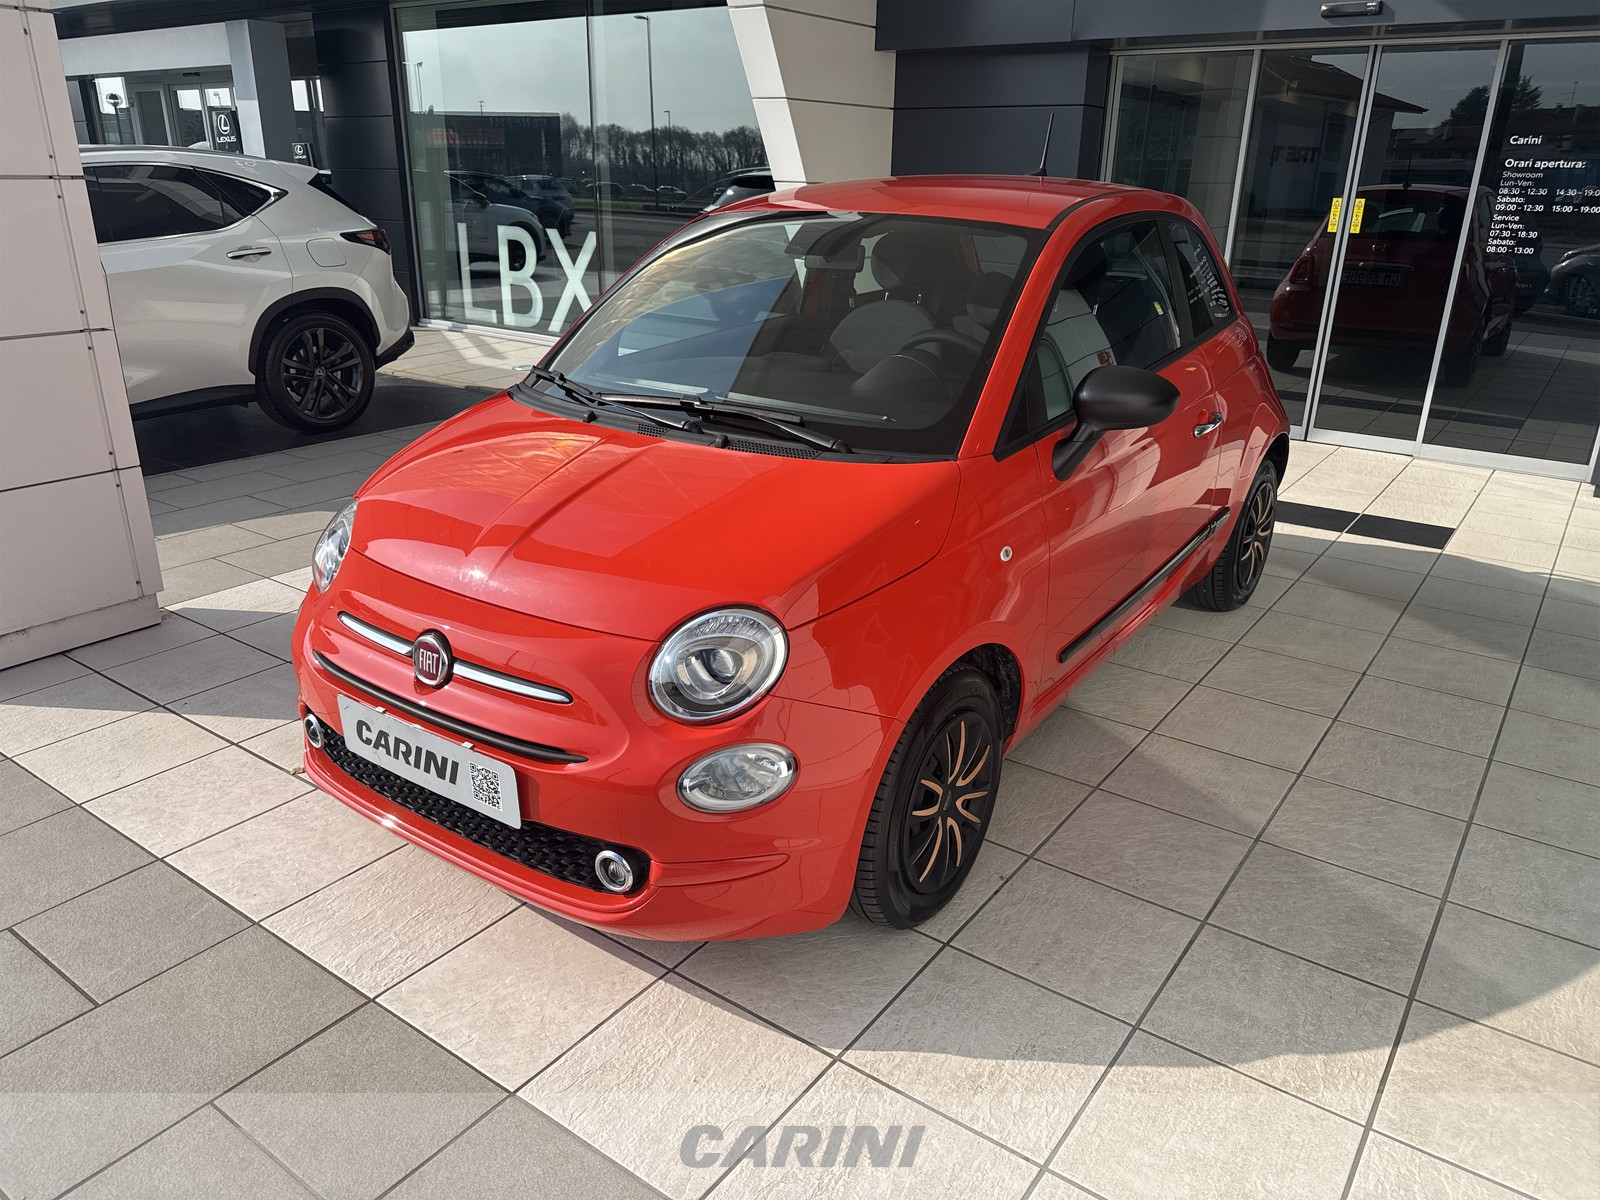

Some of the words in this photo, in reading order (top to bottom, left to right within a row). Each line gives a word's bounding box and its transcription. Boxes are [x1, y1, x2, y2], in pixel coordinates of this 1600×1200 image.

[216, 135, 237, 143] LEXUS
[1509, 134, 1543, 145] Carini
[1504, 158, 1533, 168] Orari
[1534, 160, 1587, 170] apertura:
[1502, 170, 1543, 179] Showroom
[1500, 179, 1535, 187] Lun-Ven:
[1498, 187, 1520, 195] 08:30
[1527, 188, 1548, 196] 12:30
[1556, 188, 1577, 196] 14:30
[1496, 195, 1526, 203] Sabato:
[1495, 203, 1517, 211] 09:00
[1523, 204, 1544, 212] 12:30
[1552, 205, 1573, 213] 15:00
[1580, 206, 1600, 214] 19:00
[1492, 213, 1520, 222] Service
[1490, 222, 1525, 230] Lun-Ven:
[1517, 231, 1538, 239] 18:30
[1487, 238, 1516, 246] Sabato:
[1514, 247, 1534, 255] 13:00
[457, 222, 597, 333] LBX
[419, 648, 439, 674] FIAT
[356, 719, 459, 786] CARINI
